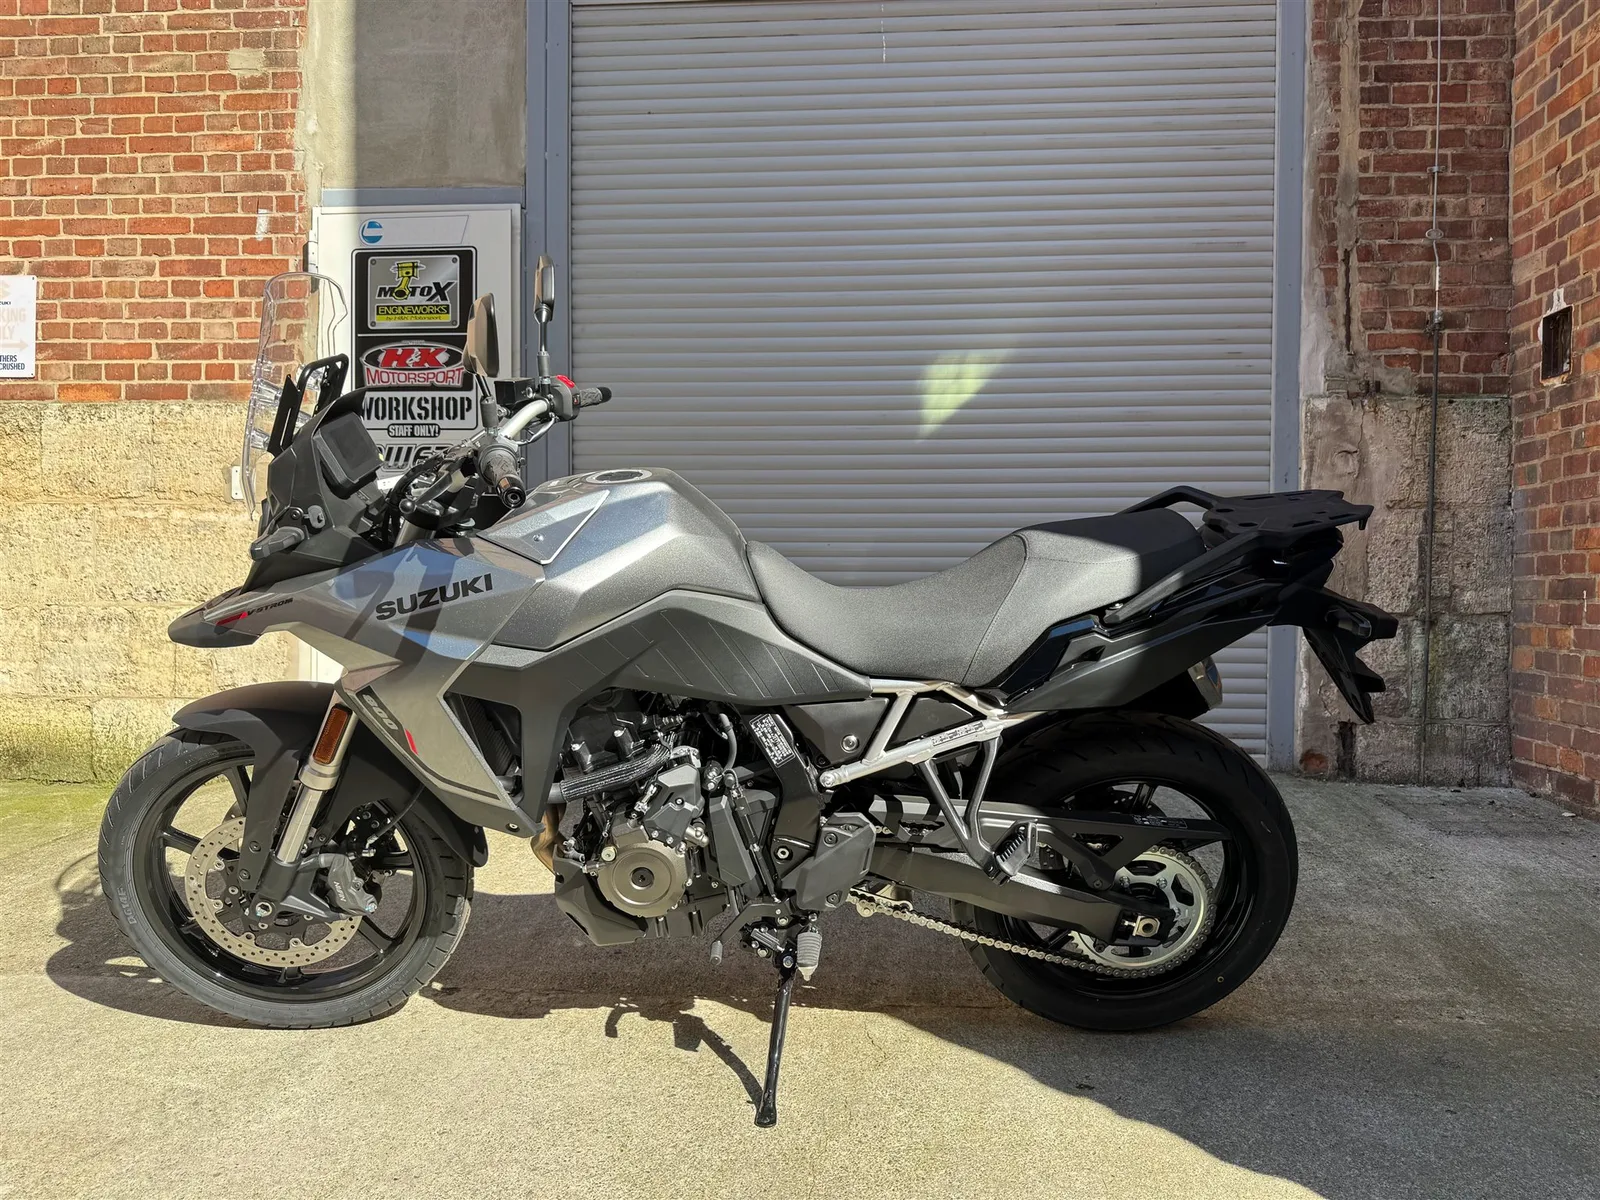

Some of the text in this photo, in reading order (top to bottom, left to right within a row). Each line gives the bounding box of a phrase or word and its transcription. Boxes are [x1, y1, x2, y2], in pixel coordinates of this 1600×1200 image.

[378, 305, 448, 315] ENGINEWORKS
[380, 348, 447, 368] H&K
[366, 367, 465, 385] MOTORSPORT
[362, 396, 473, 420] WORKSHOP
[389, 424, 439, 436] STAFF ONLY!
[376, 573, 494, 621] SUZUKI
[362, 694, 399, 730] 800
